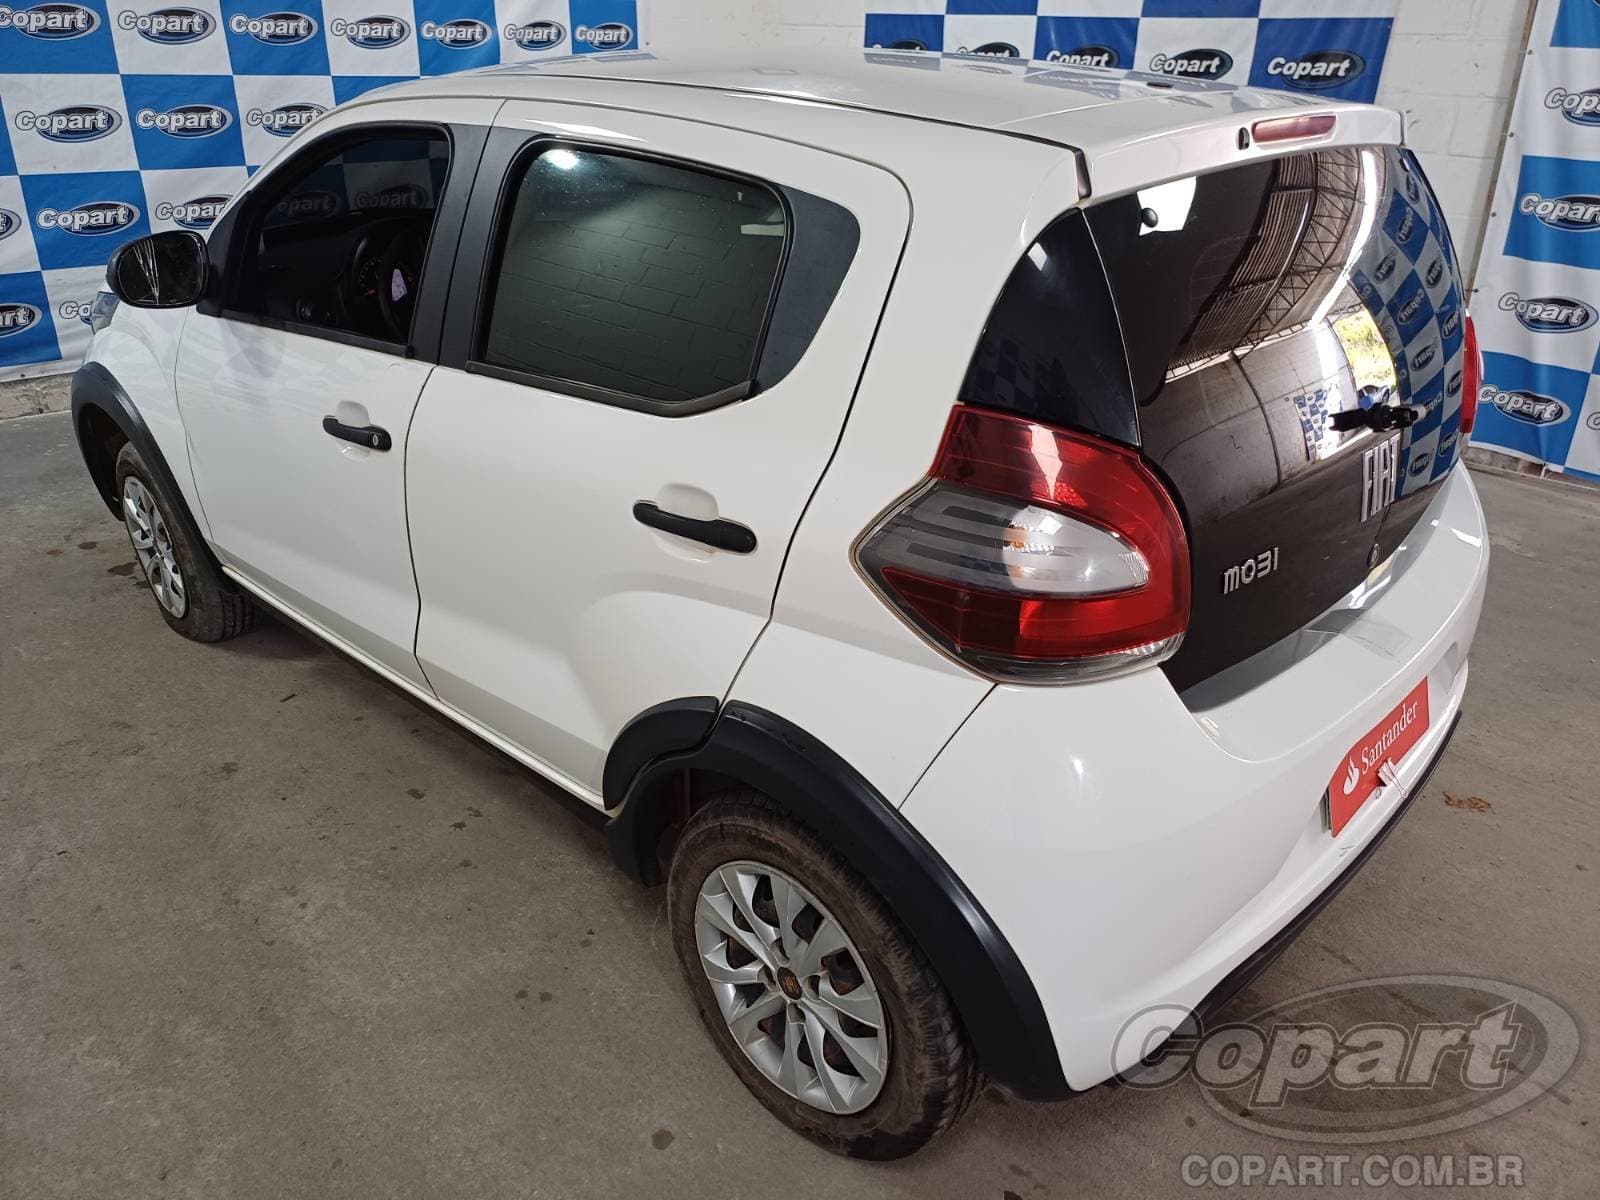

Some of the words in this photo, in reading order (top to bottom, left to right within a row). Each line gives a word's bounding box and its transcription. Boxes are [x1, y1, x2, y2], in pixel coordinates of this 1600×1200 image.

[0, 6, 87, 33] Copart
[118, 11, 204, 35] Copart
[230, 14, 309, 38] Copart
[331, 18, 401, 43] Copart
[421, 21, 483, 44] Copart
[504, 23, 558, 44] Copart
[575, 25, 628, 45] Copart
[1150, 53, 1221, 74] Copart
[1267, 56, 1351, 79] Copart
[15, 109, 107, 134] Copart
[136, 108, 223, 132] Copart
[37, 203, 129, 231] Copart
[155, 202, 227, 223] Copar
[1521, 193, 1600, 223] Copar
[1498, 292, 1586, 326] Copart
[1478, 384, 1564, 420] Copart
[1361, 432, 1401, 522] FIAT
[1361, 701, 1418, 775] Santander
